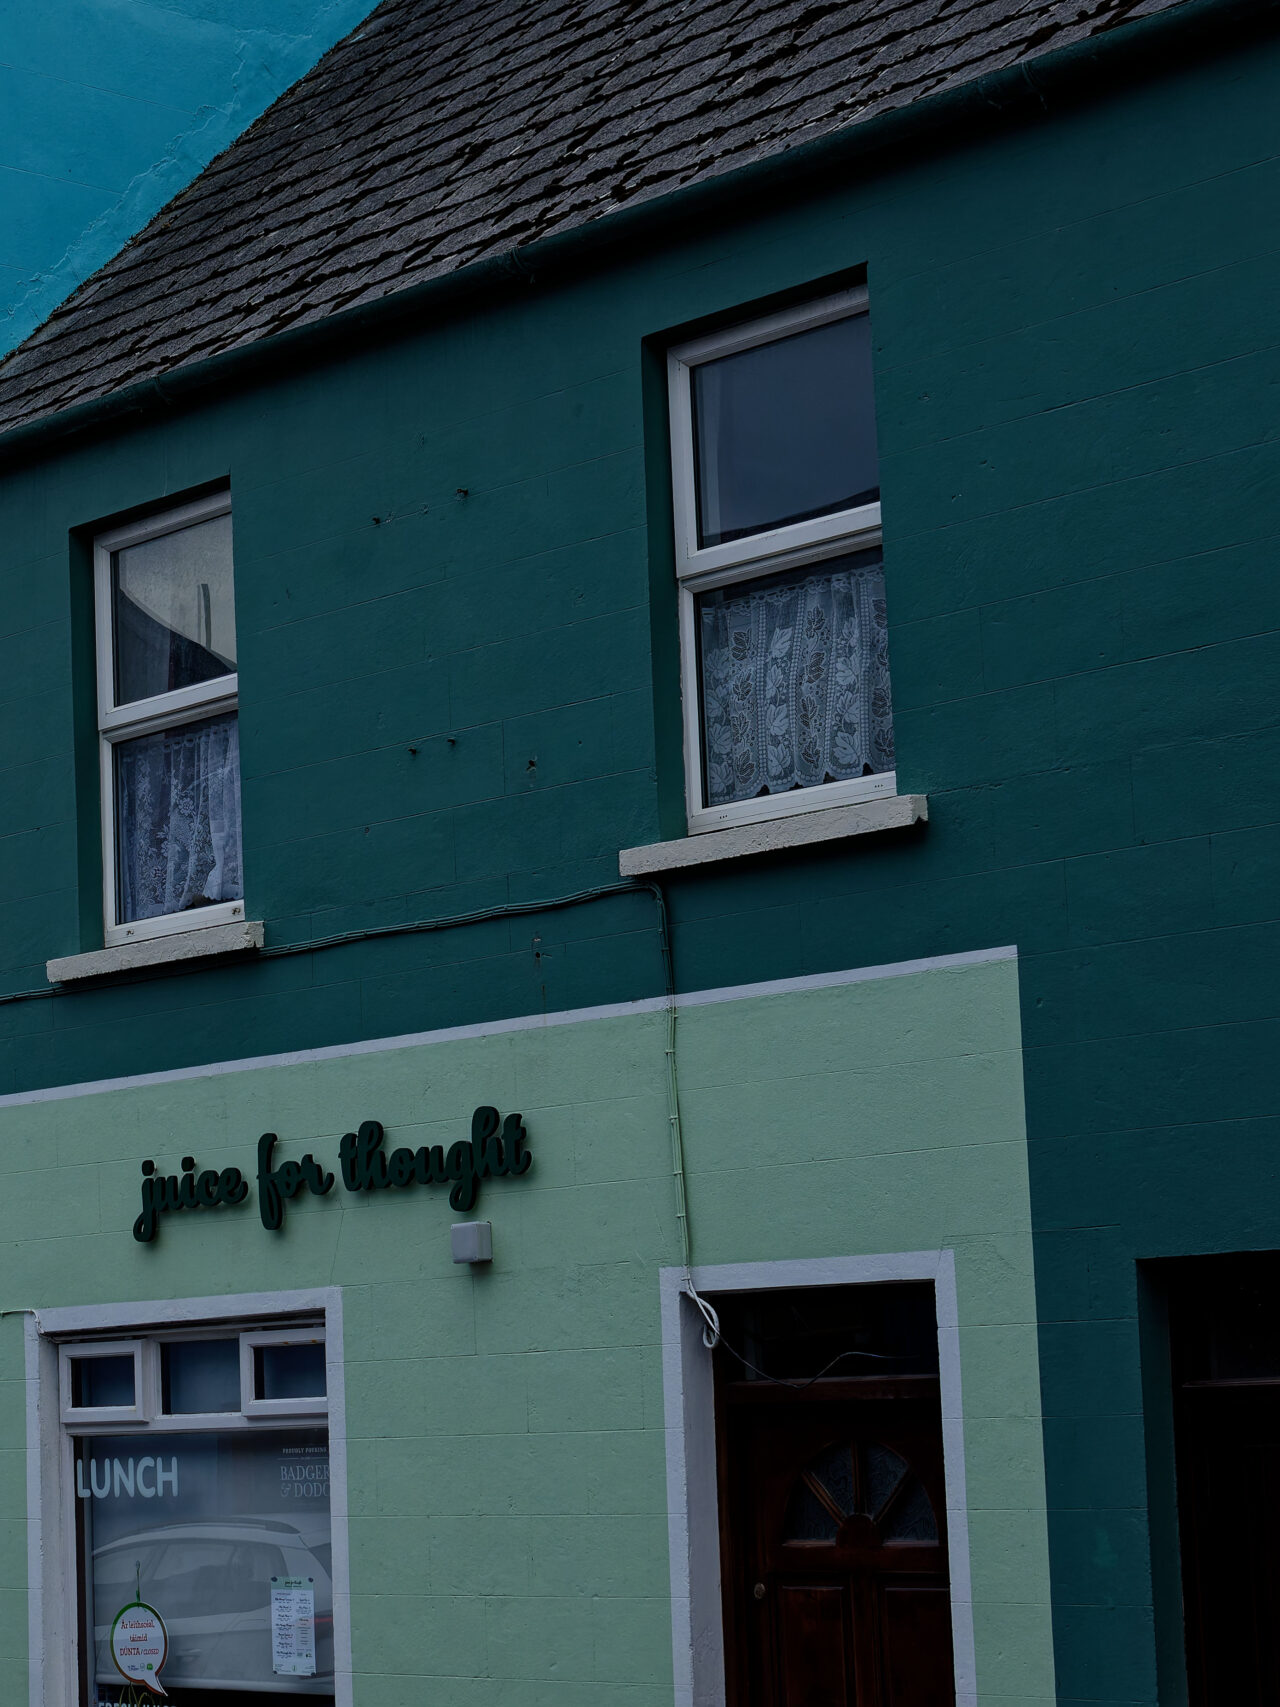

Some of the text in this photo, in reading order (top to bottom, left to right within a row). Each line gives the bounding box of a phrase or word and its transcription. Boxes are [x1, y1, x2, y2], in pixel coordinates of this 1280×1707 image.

[133, 1106, 532, 1242] juice for thought
[76, 1456, 179, 1499] LUNCH
